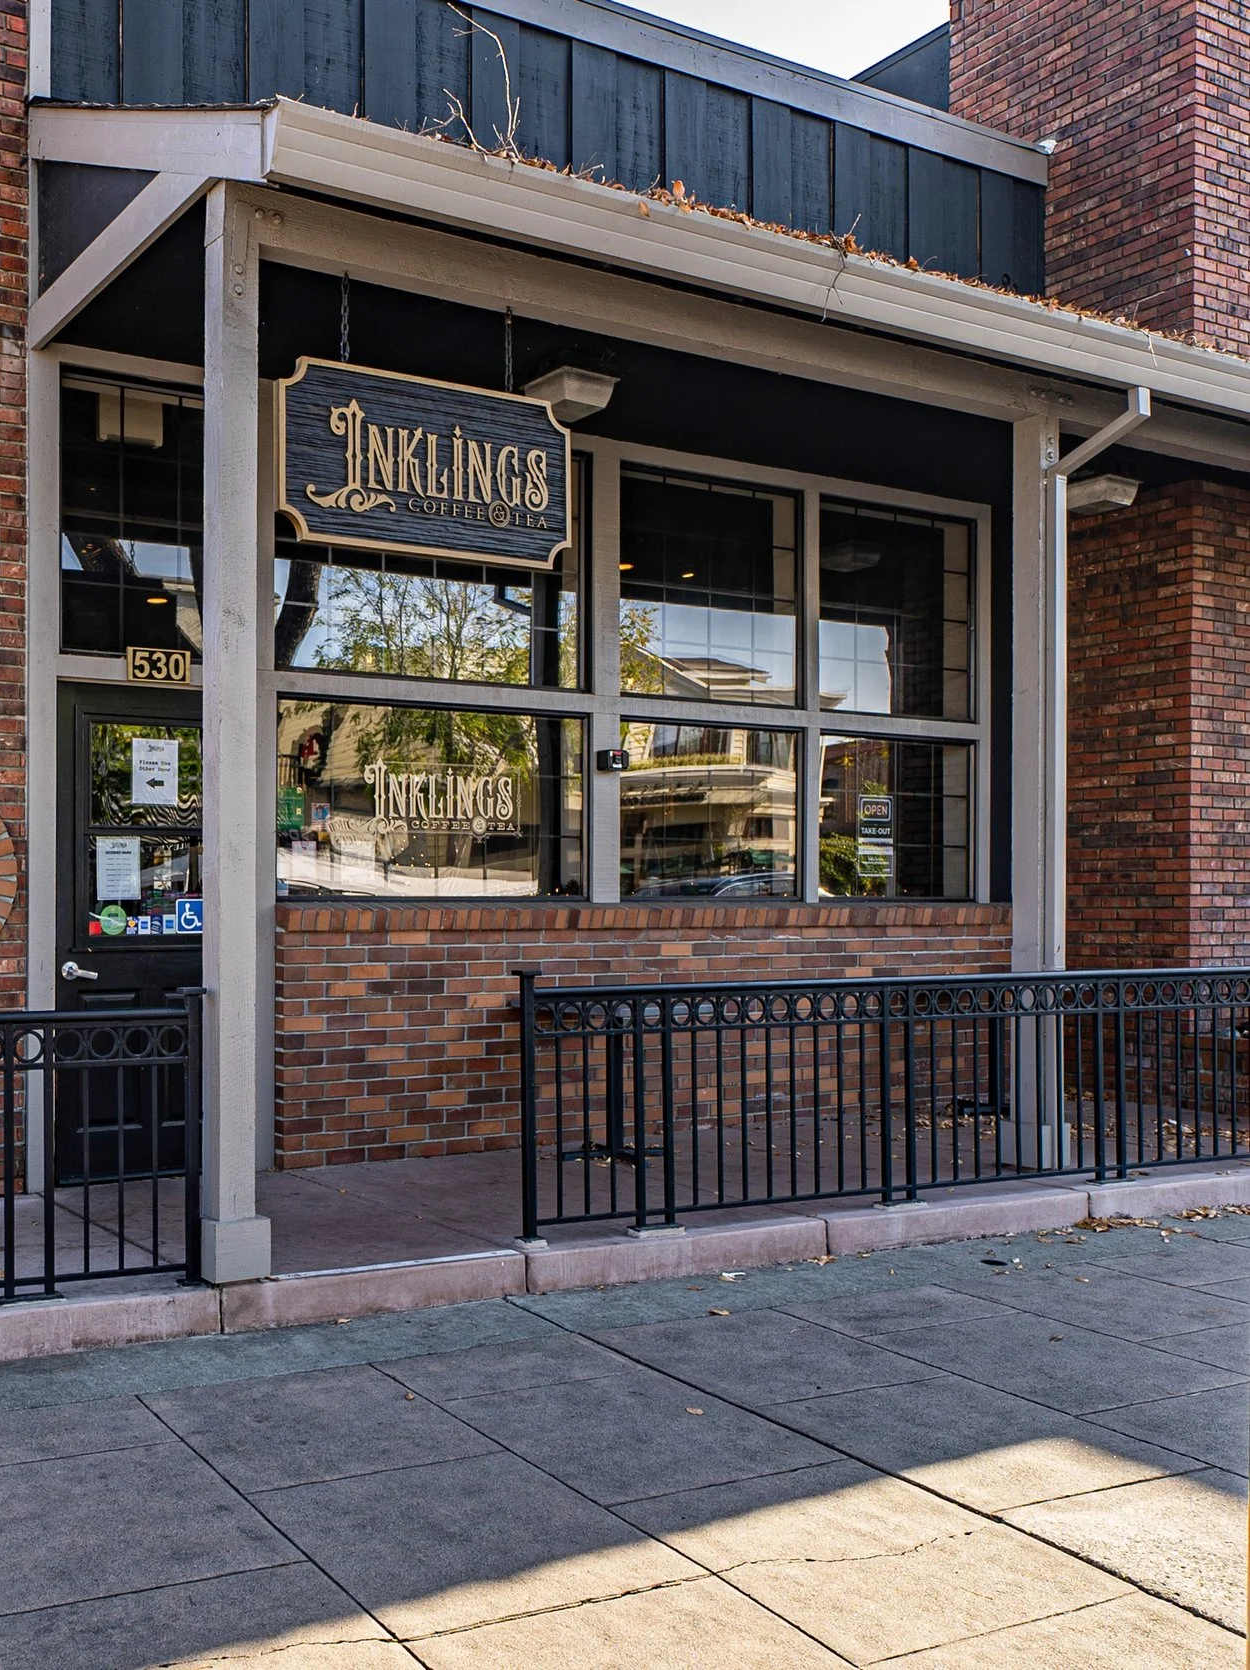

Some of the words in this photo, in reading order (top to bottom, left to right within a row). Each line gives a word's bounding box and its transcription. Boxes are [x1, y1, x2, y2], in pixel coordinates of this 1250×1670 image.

[306, 399, 549, 512] INKLINGS
[408, 498, 485, 521] COFFEE
[512, 511, 548, 529] TEA
[133, 651, 185, 681] 530
[350, 757, 514, 834] INKLINGS
[864, 805, 888, 816] OPEN
[411, 820, 471, 830] COFFEE
[488, 823, 515, 831] TEA
